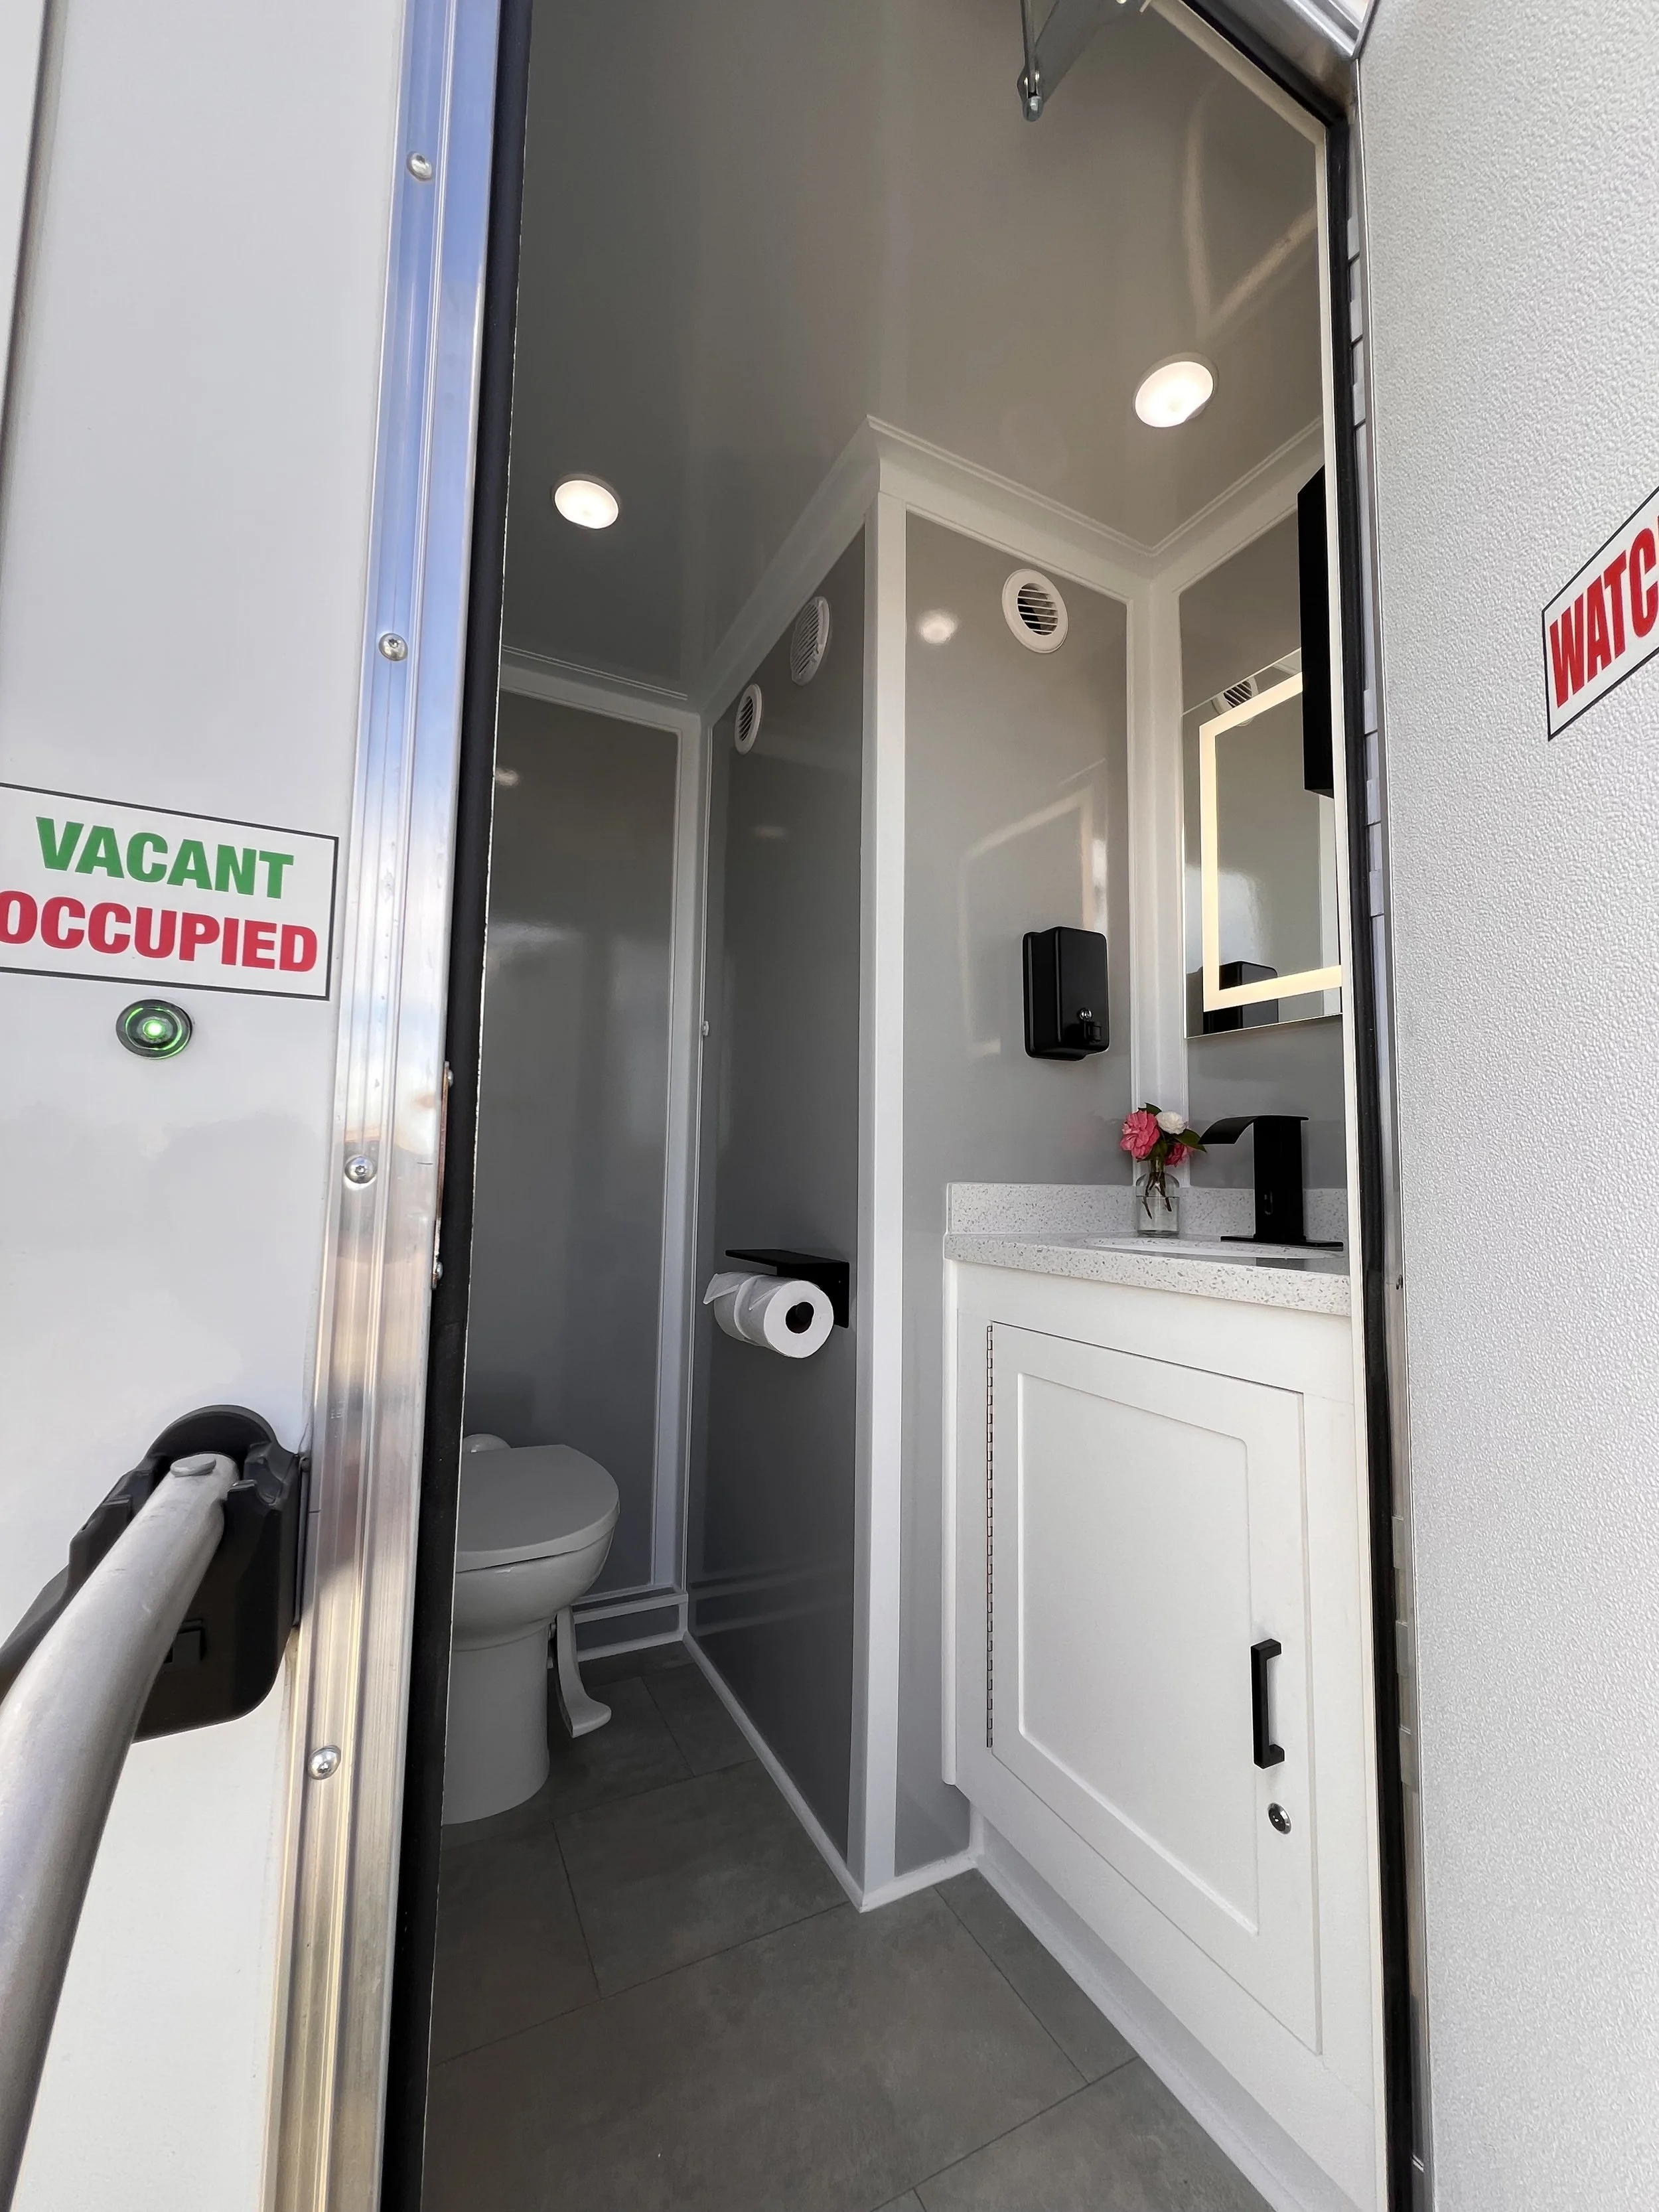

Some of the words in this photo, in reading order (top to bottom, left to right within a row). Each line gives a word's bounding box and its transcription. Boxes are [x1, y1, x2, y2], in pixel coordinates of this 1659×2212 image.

[1549, 514, 1659, 708] WATC
[36, 816, 294, 899] VACANT
[0, 890, 318, 972] OCCUPIED
